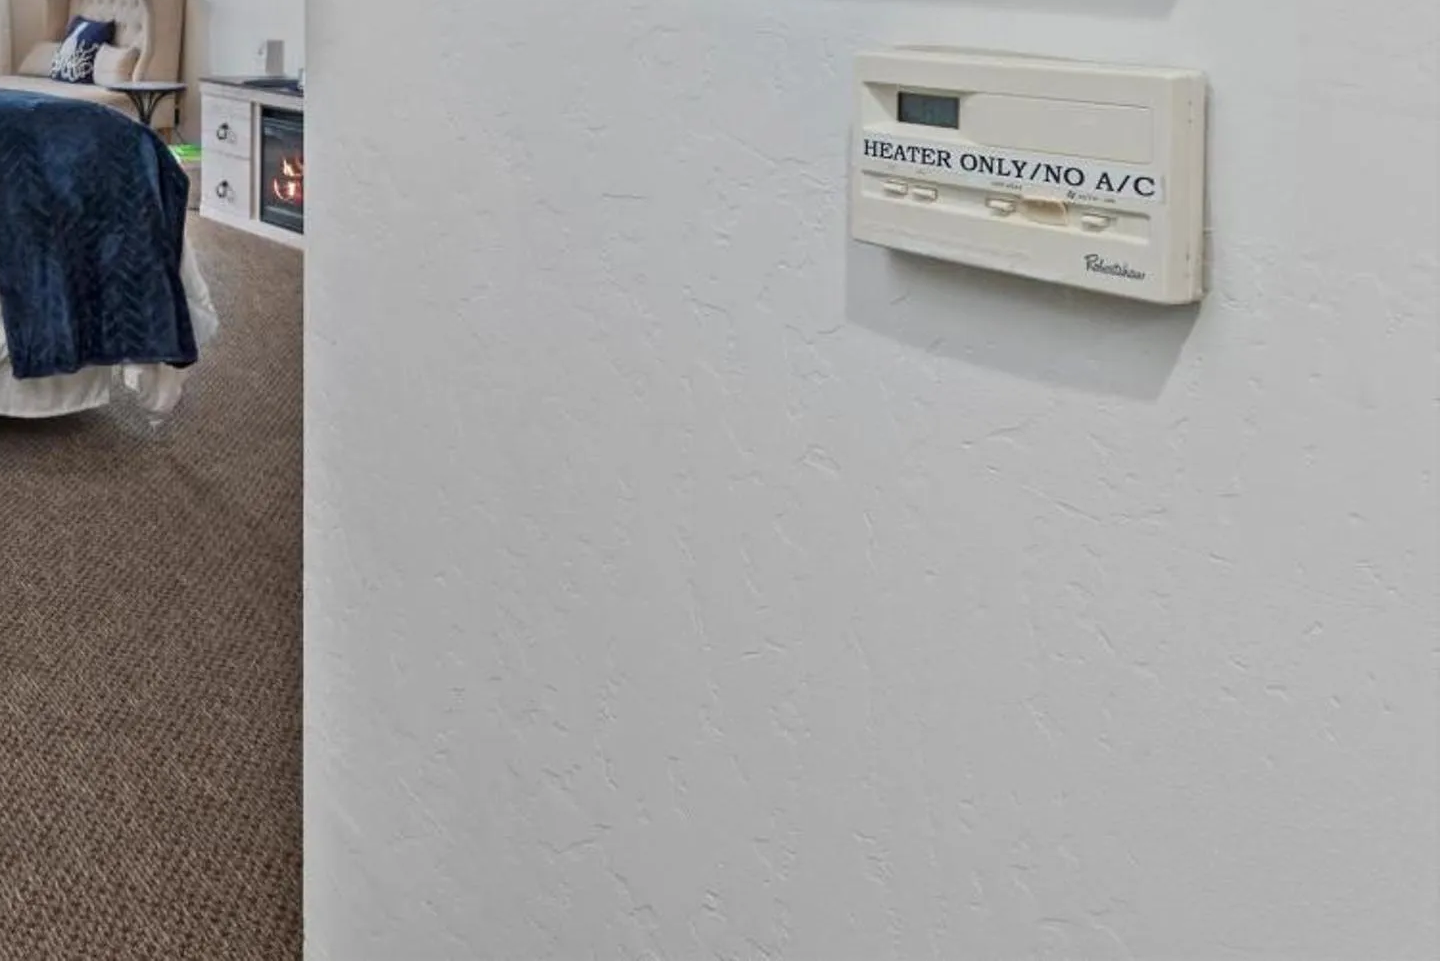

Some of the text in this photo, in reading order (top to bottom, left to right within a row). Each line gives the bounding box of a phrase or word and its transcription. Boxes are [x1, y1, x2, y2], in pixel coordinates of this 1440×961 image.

[863, 138, 953, 169] HEATER
[959, 152, 1085, 188] ONLY/NO
[1095, 171, 1156, 199] A/C
